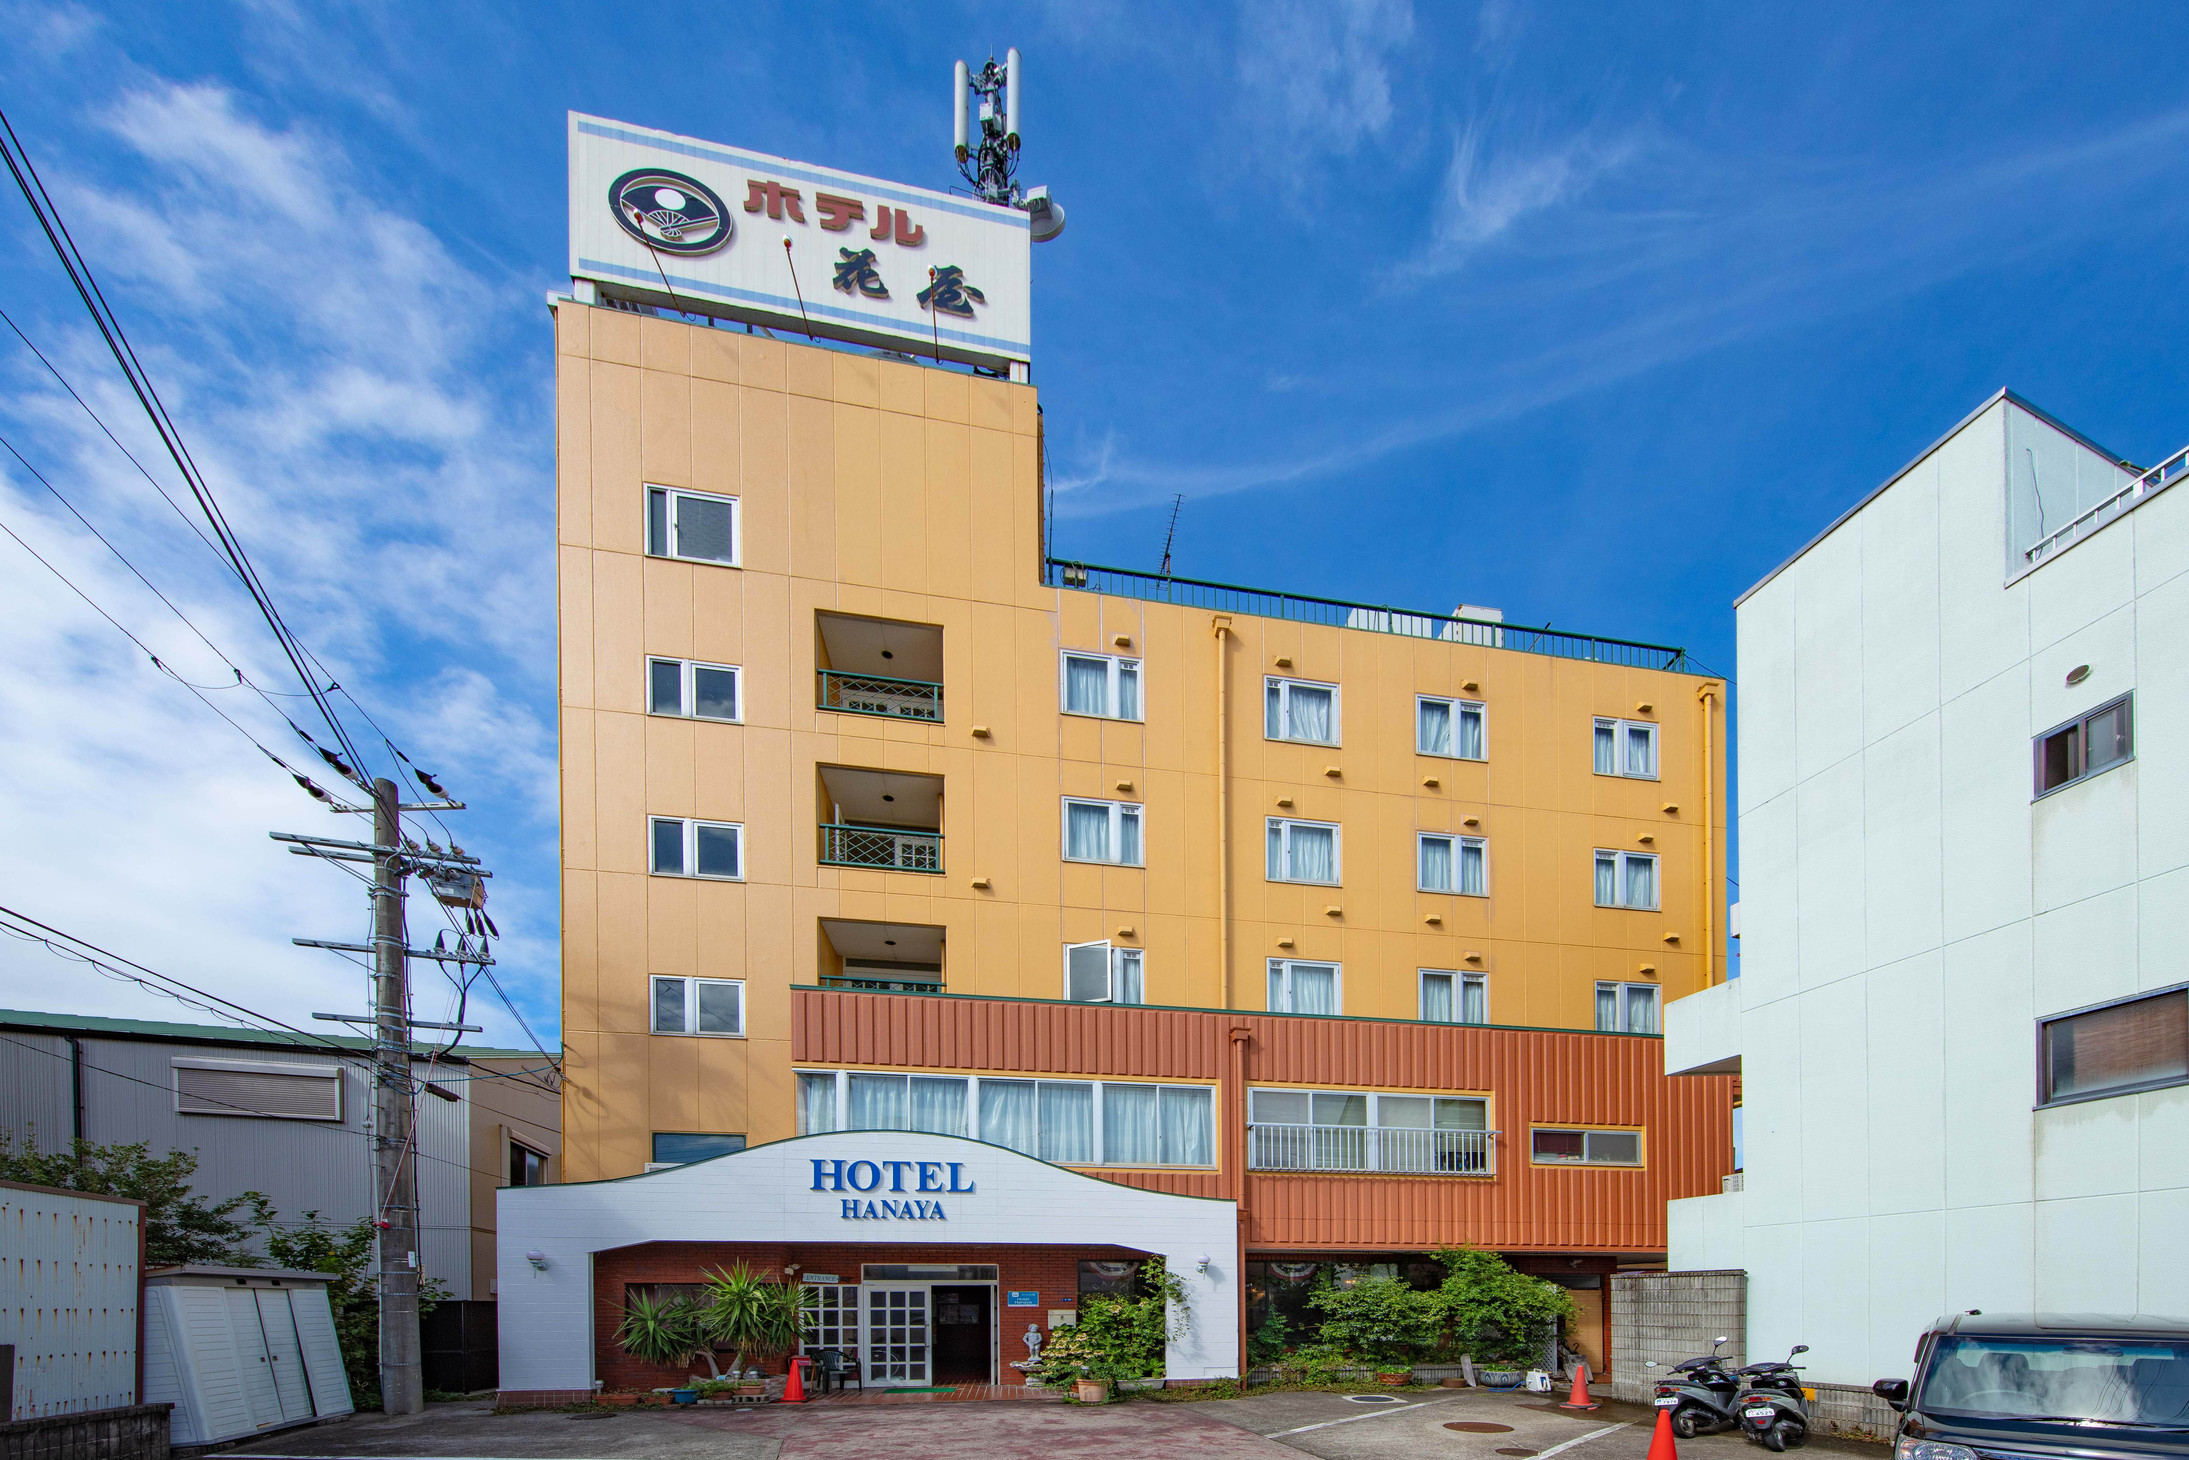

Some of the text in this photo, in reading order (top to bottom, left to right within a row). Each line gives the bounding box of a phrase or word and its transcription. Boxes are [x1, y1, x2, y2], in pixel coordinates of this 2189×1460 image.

[743, 179, 924, 247] ホテル
[809, 1159, 975, 1193] HOTEL
[841, 1199, 947, 1219] HANAYA
[806, 1274, 837, 1282] ENTRANCE
